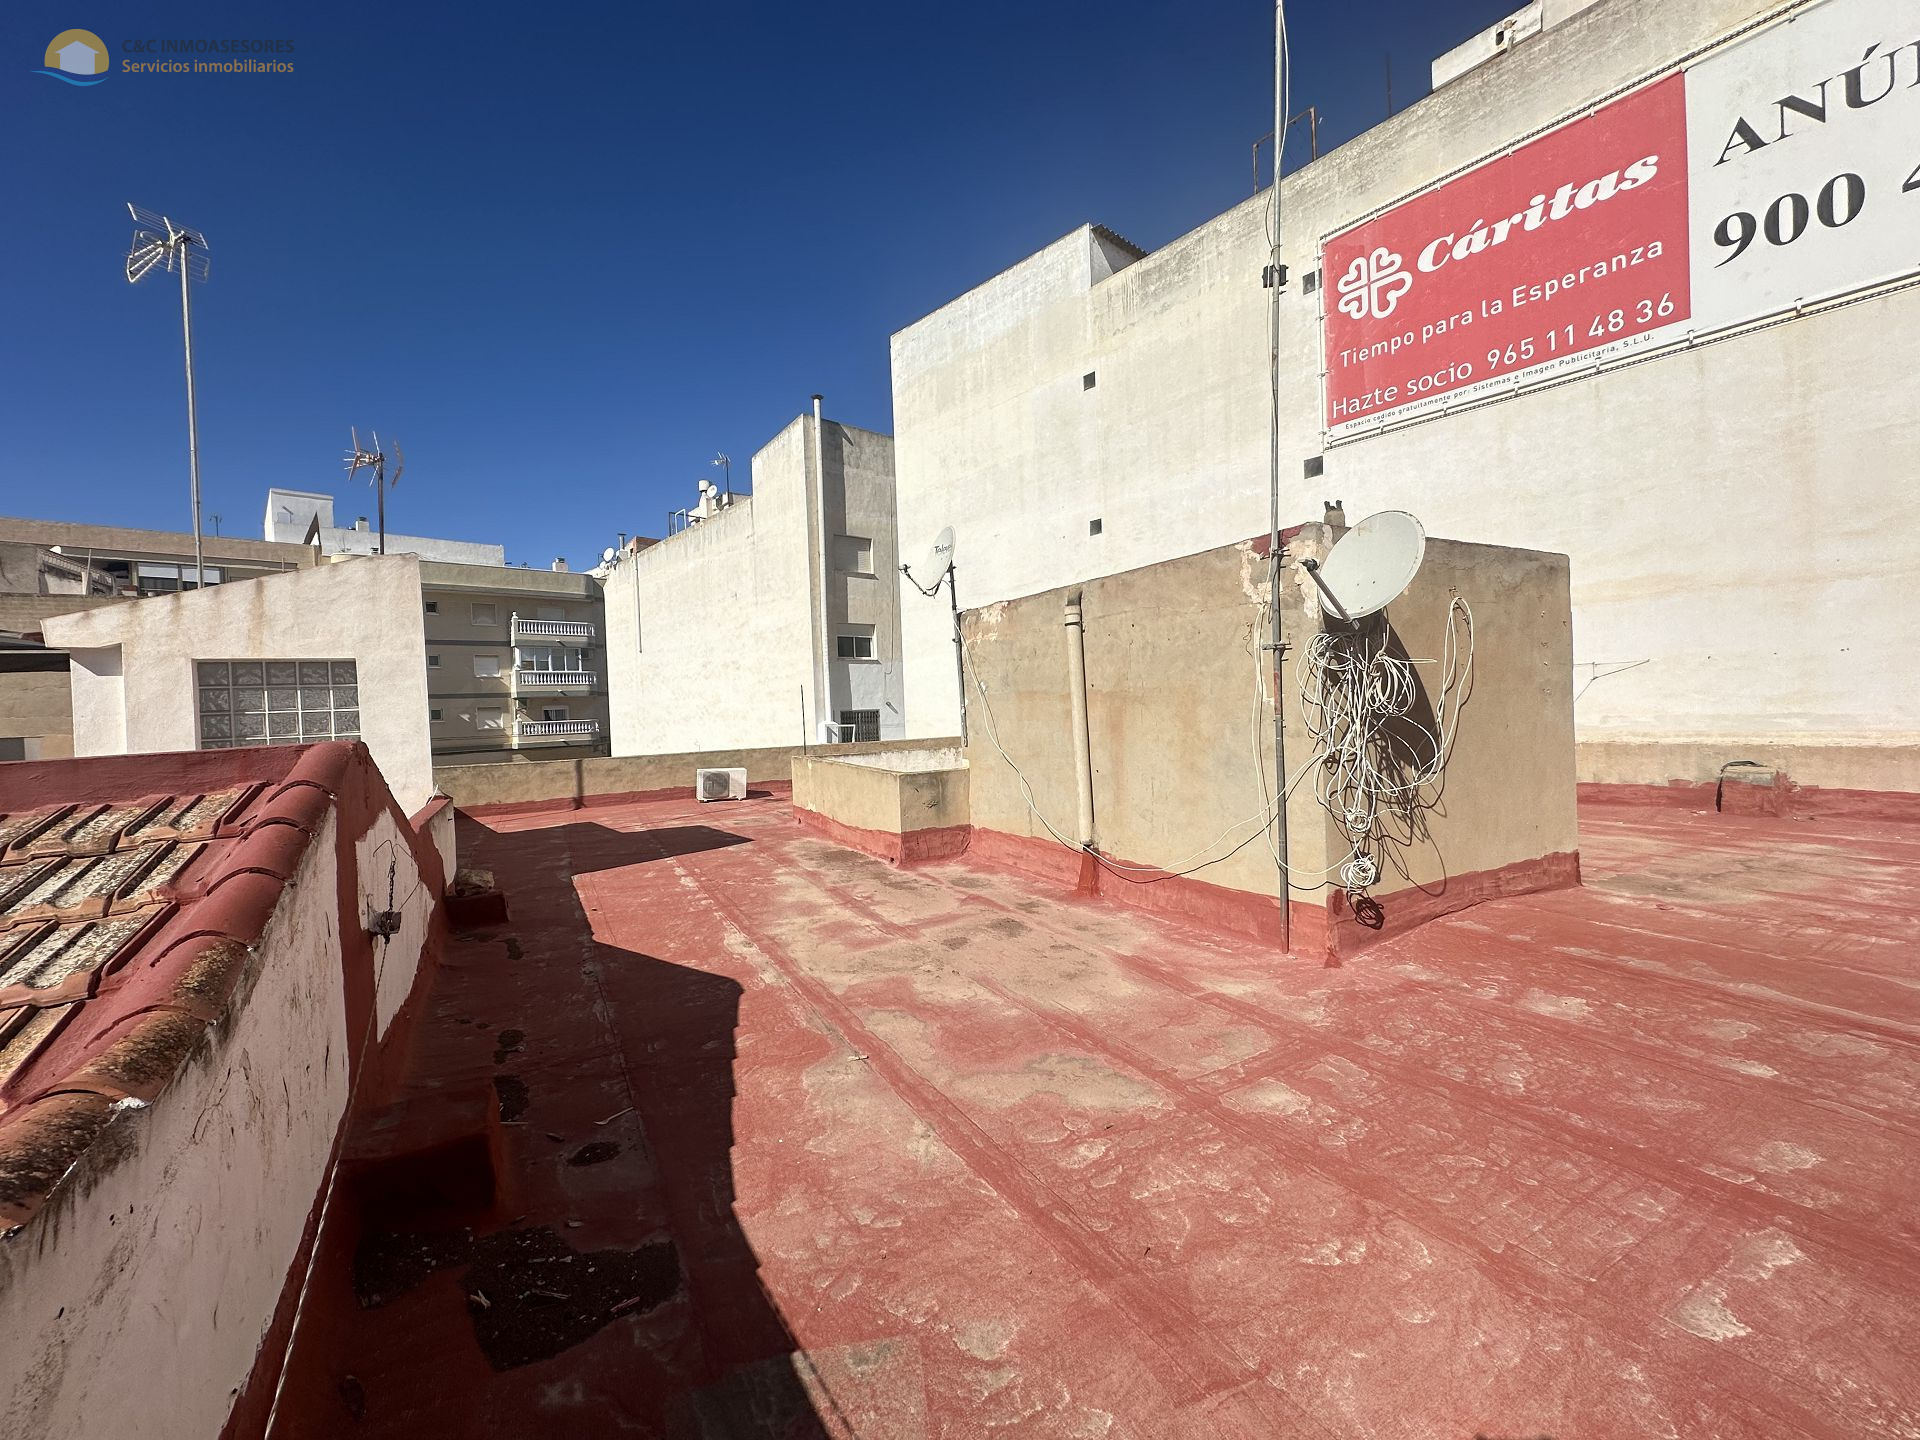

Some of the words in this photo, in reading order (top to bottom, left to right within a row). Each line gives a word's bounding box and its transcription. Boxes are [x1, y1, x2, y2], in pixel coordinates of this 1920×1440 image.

[1416, 153, 1660, 275] Cáritas
[1713, 172, 1866, 269] 900
[1332, 386, 1399, 418] Hazte
[1406, 361, 1473, 396] socio
[1486, 337, 1535, 370] 965
[1546, 324, 1575, 352] 11
[1587, 309, 1626, 338] 48
[1635, 292, 1676, 323] 36
[1340, 331, 1415, 368] Tiempo
[1421, 308, 1474, 344] para
[1481, 298, 1504, 318] la
[1511, 240, 1664, 308] Esperanza
[1345, 417, 1371, 430] Espacio
[1373, 411, 1396, 422] cedido
[1399, 395, 1451, 415] gratuitamente
[1473, 376, 1512, 392] Sistemas
[1522, 363, 1556, 379] Imagen
[1622, 333, 1655, 348] S.L.U.
